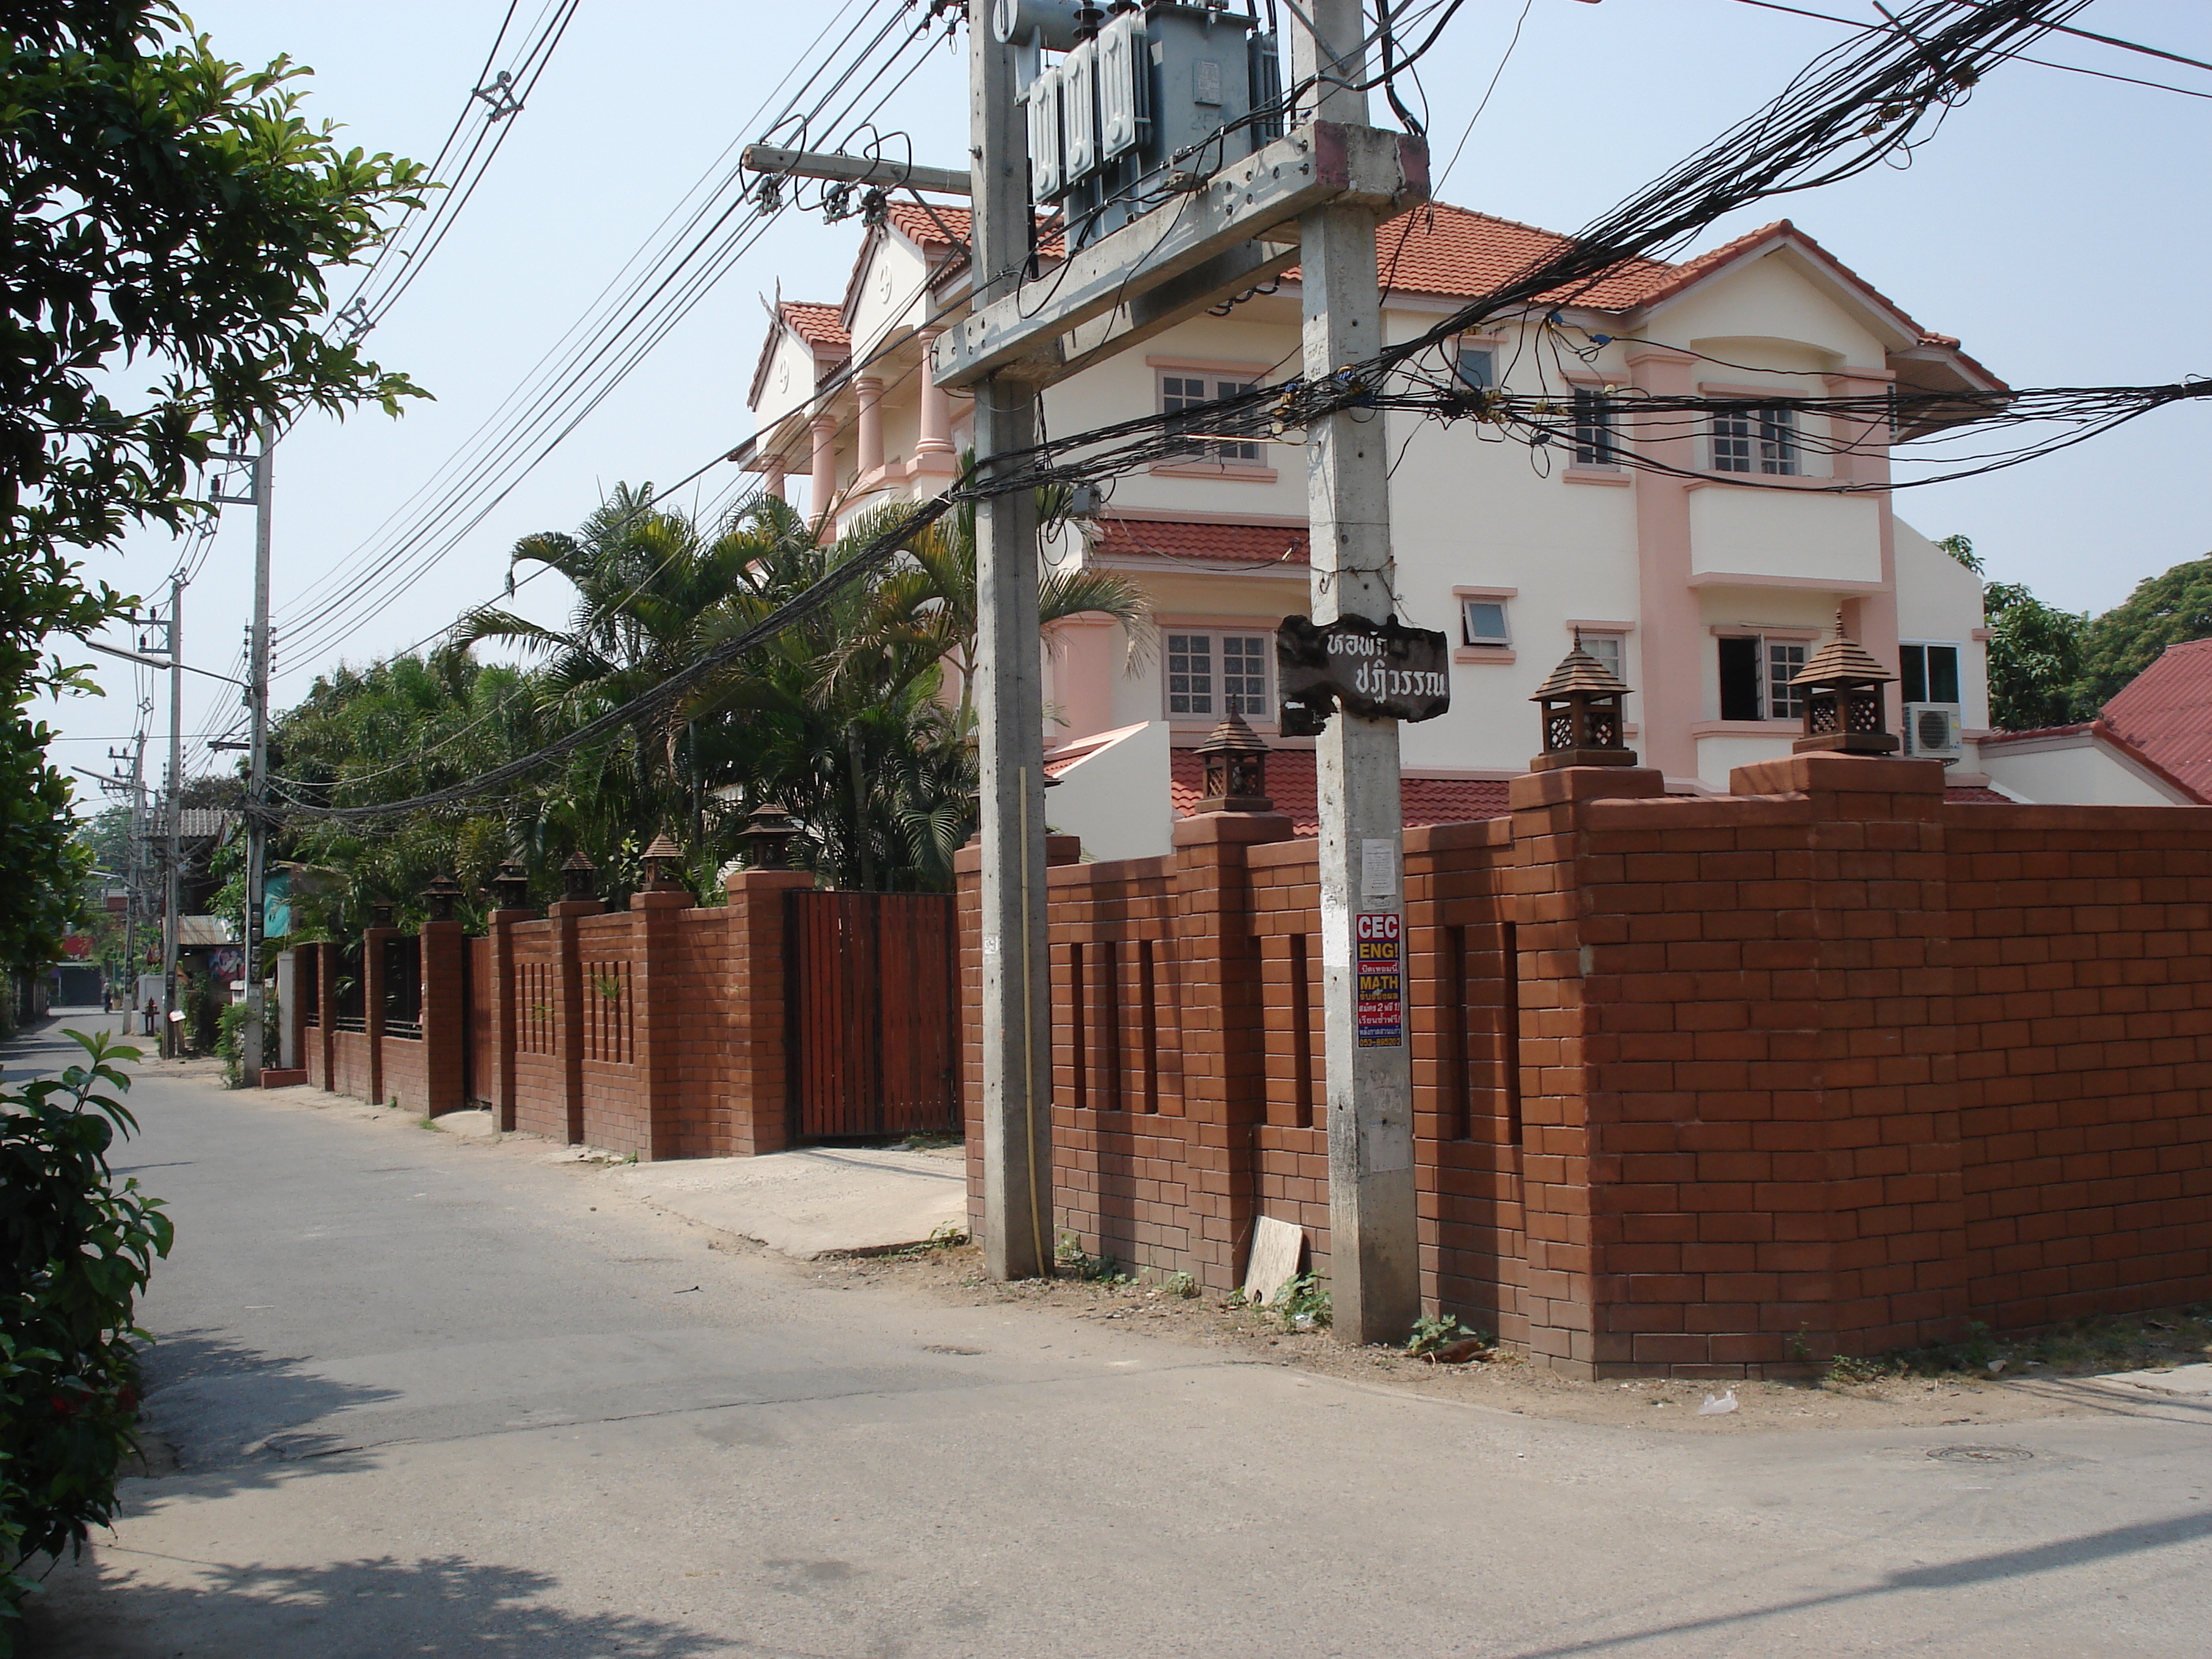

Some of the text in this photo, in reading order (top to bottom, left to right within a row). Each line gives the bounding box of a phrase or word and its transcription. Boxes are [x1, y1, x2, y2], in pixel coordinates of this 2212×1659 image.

[1327, 631, 1388, 657] หอพัก
[1358, 916, 1398, 939] CEC
[1360, 943, 1398, 958] ENG!
[1361, 976, 1398, 990] MATH
[1377, 1002, 1383, 1012] 2
